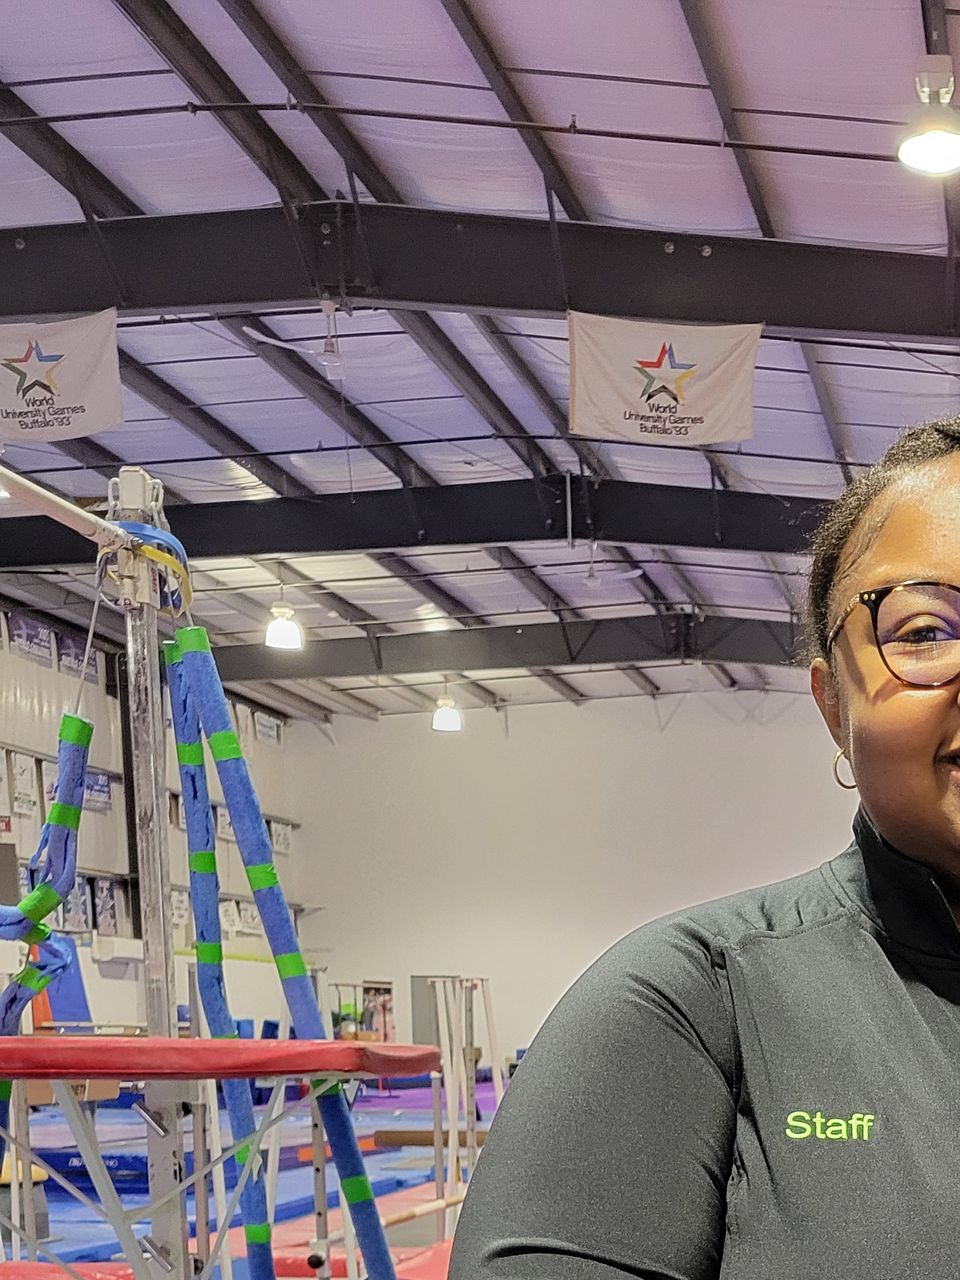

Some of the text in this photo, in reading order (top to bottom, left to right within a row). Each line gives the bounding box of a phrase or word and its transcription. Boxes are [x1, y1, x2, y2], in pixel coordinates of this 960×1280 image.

[25, 396, 55, 407] World
[1, 405, 86, 420] University Games
[648, 403, 678, 414] World
[18, 417, 55, 430] Buffalo
[624, 411, 705, 426] University Games
[640, 424, 672, 435] Buffalo
[785, 1111, 875, 1140] Staff
